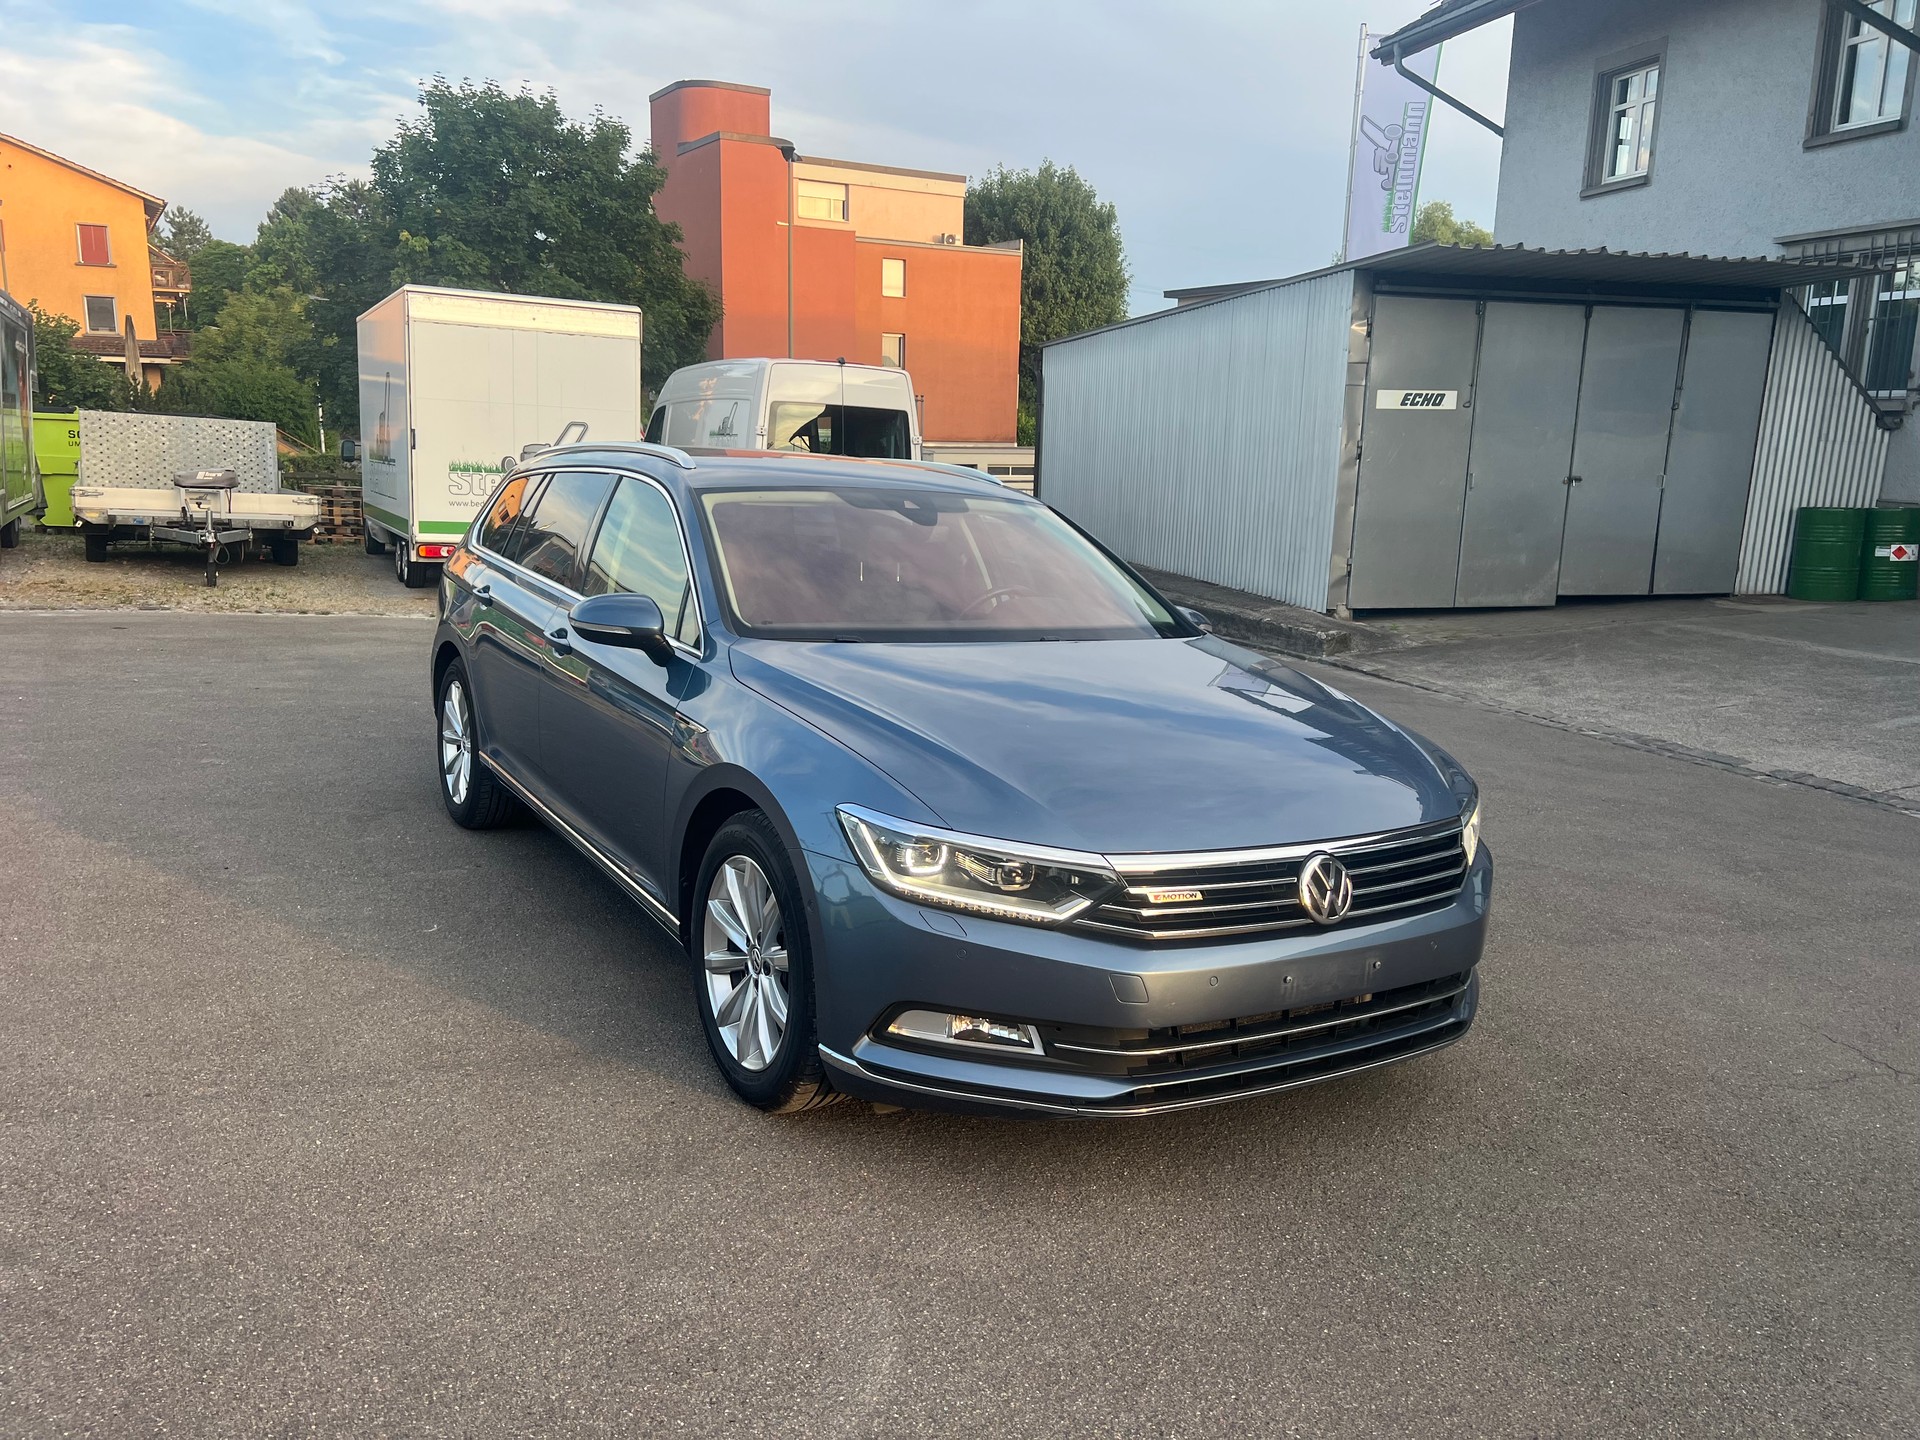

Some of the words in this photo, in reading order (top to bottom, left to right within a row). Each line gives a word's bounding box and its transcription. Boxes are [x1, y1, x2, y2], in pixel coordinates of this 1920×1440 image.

[1389, 101, 1426, 233] Steinmann
[1400, 392, 1446, 407] ECHO
[448, 473, 506, 497] Ste
